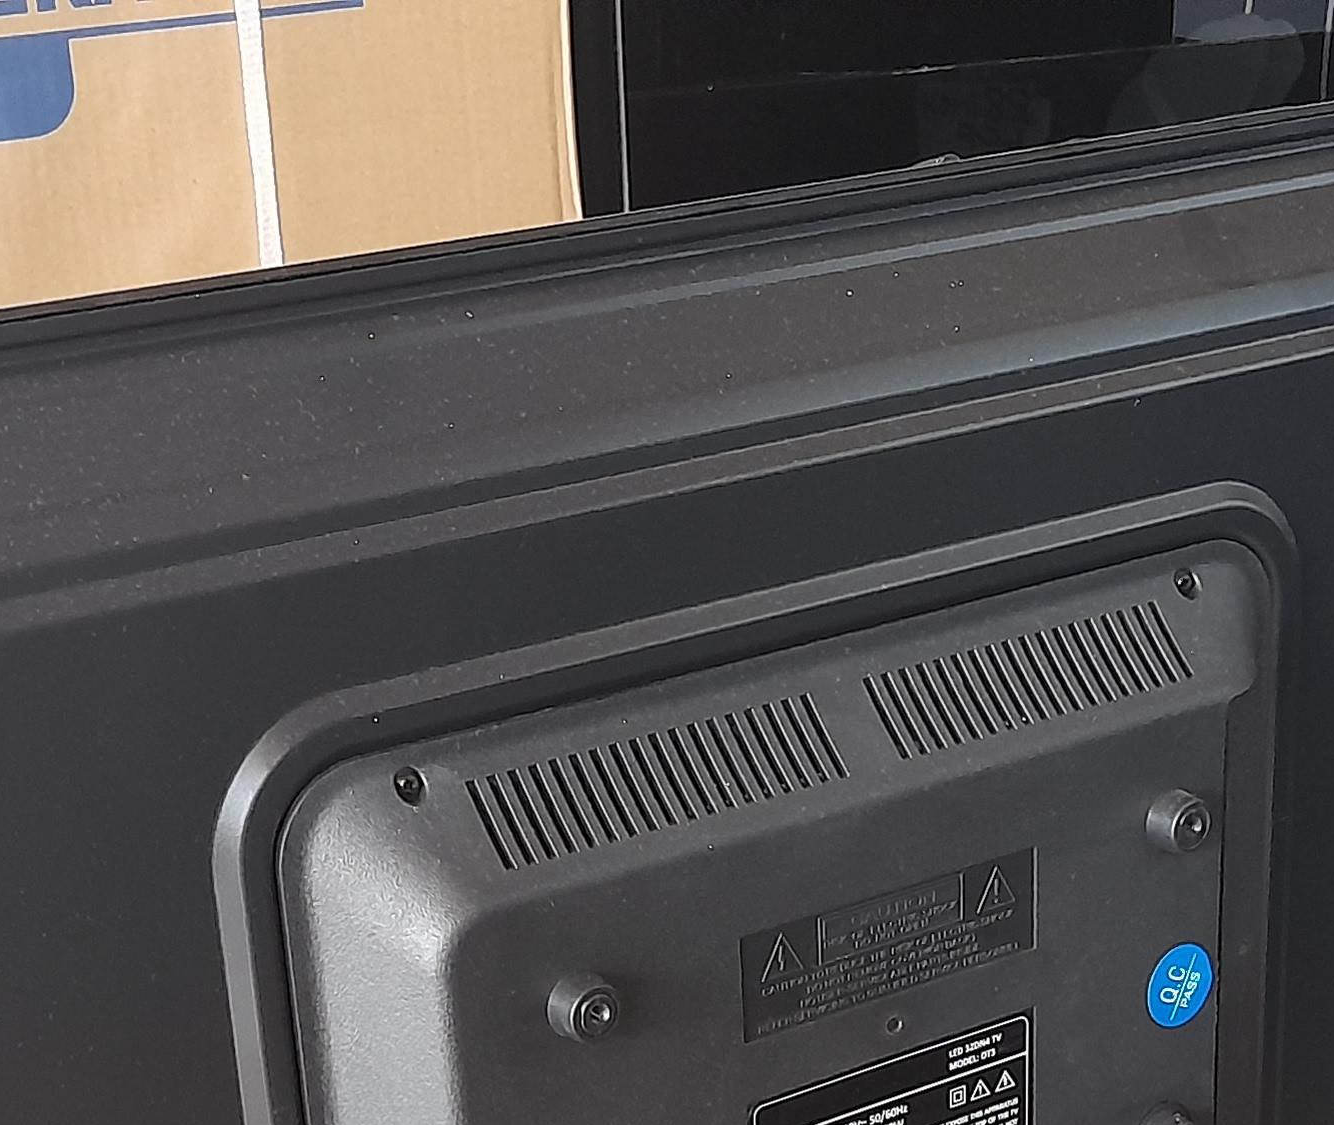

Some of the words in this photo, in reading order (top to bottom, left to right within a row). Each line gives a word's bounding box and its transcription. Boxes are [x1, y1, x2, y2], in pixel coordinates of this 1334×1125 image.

[1179, 970, 1201, 1008] PASS
[948, 1046, 964, 1058] LED
[991, 1033, 1002, 1044] TV
[949, 1055, 979, 1071] MODEL:
[869, 1105, 908, 1125] 50/60Hz
